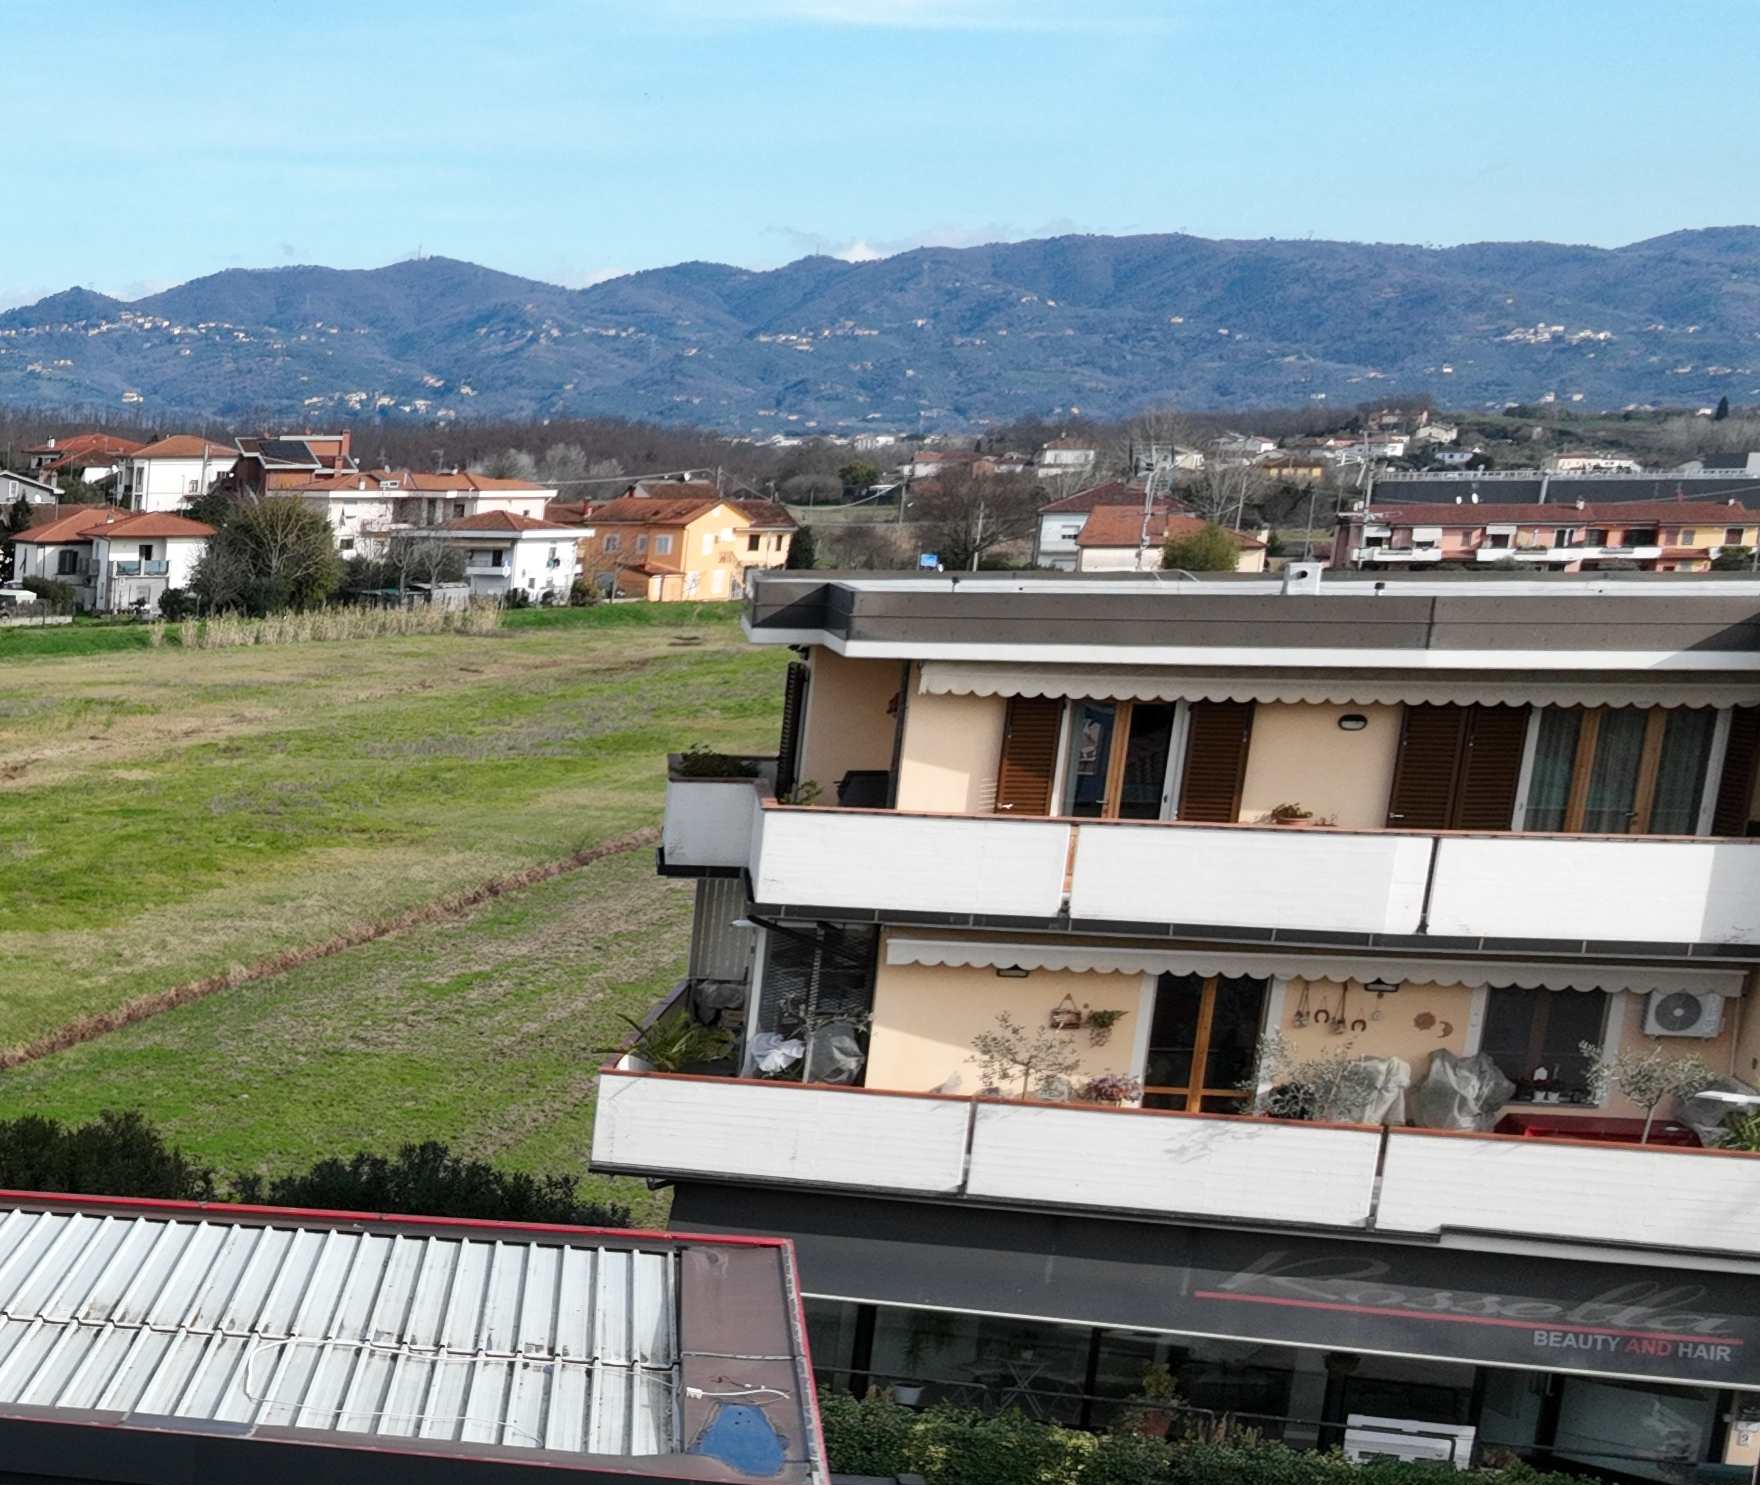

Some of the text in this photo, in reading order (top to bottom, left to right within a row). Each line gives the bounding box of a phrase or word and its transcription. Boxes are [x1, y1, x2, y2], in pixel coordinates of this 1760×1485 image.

[1217, 1250, 1734, 1334] Rossella
[1533, 1330, 1731, 1362] BEAUTY AND HAIR
